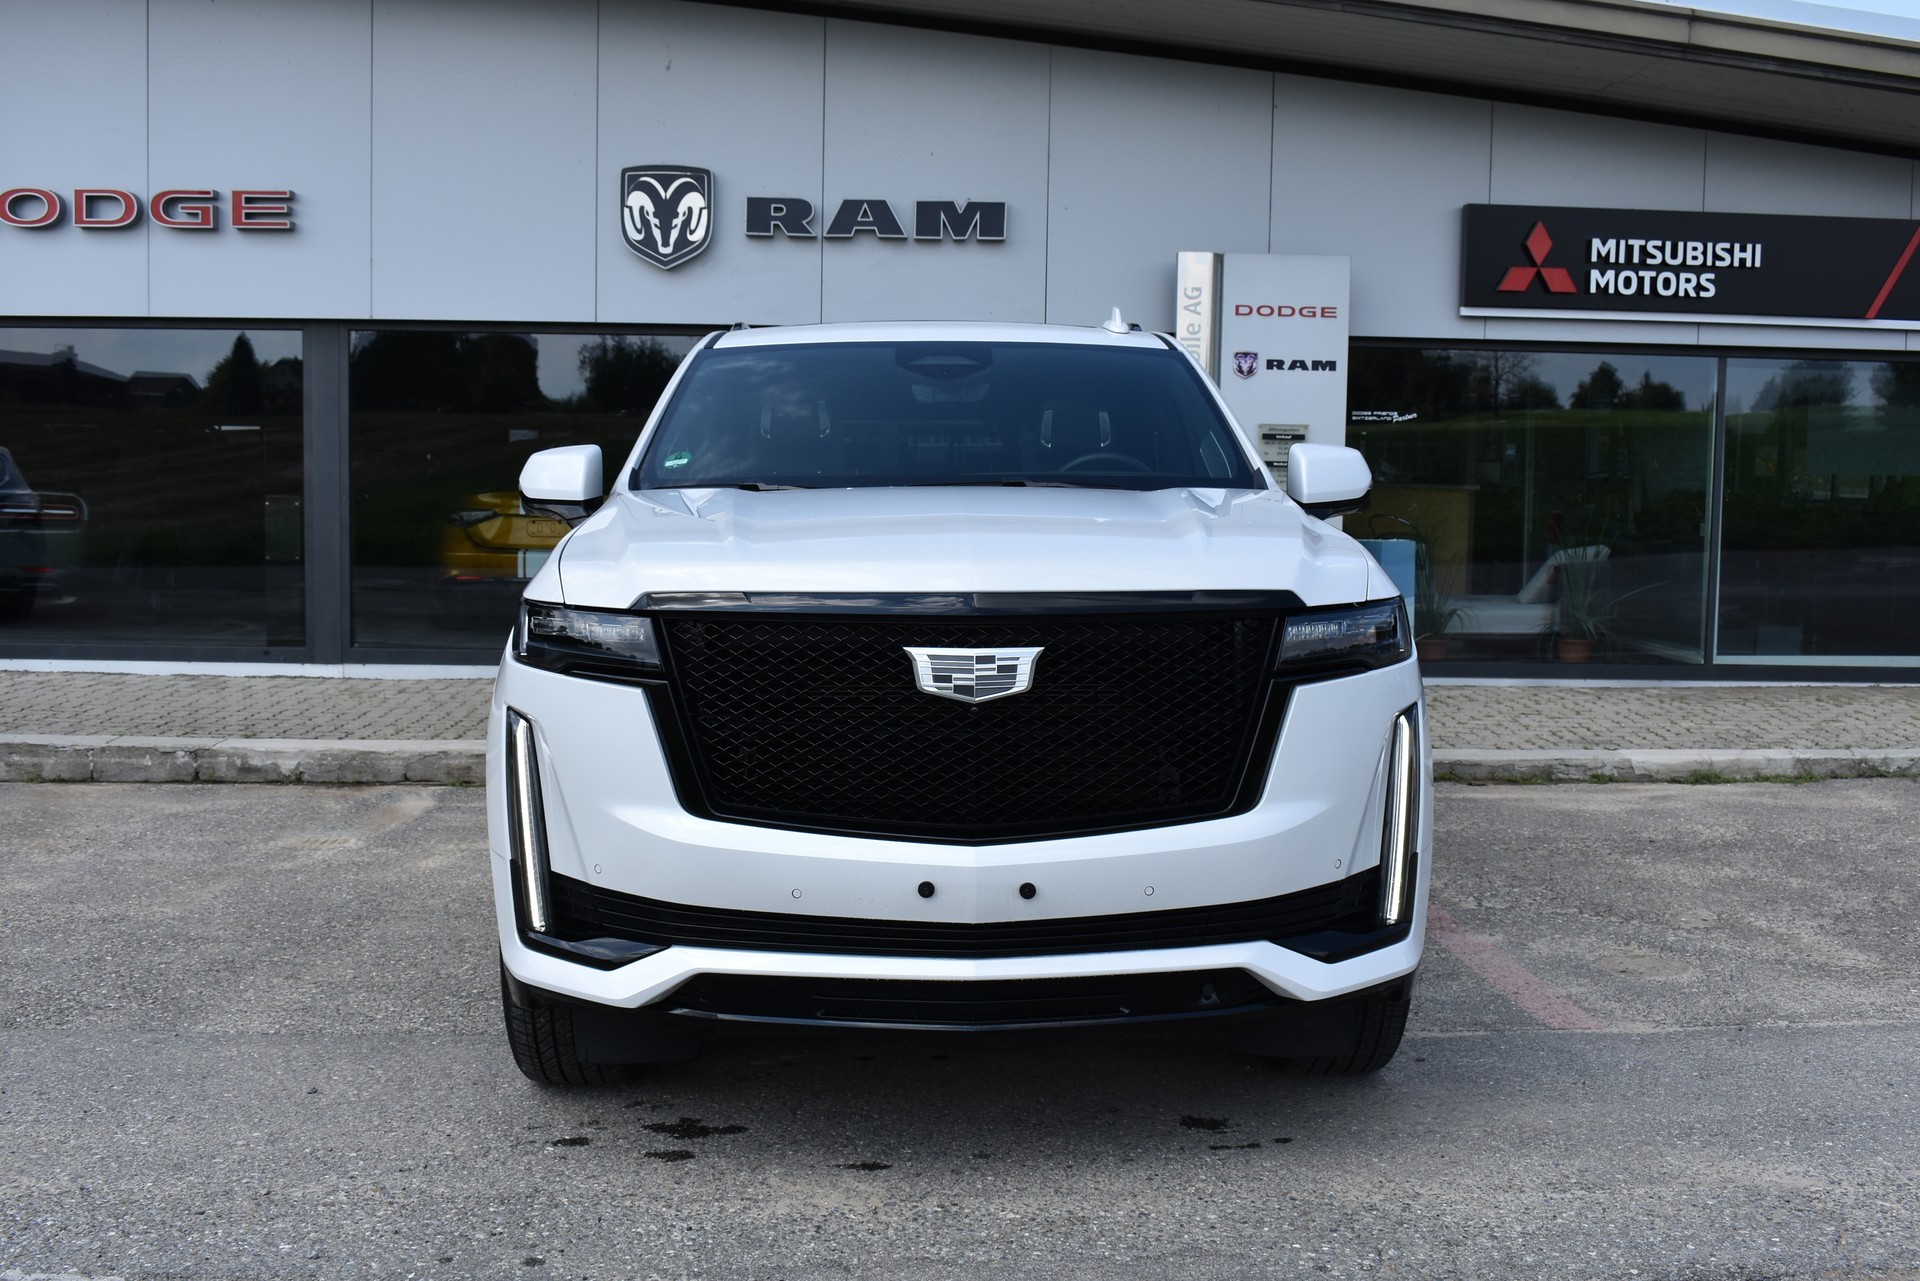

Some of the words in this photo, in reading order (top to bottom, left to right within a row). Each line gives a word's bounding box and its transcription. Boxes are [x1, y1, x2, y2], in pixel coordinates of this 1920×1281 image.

[0, 188, 293, 229] ODGE
[745, 197, 1007, 240] RAM
[1591, 237, 1762, 268] MITSUBISHI
[1589, 269, 1716, 298] MOTORS
[1183, 286, 1203, 316] AG
[1234, 304, 1338, 319] DODGE
[1265, 359, 1337, 372] RAM
